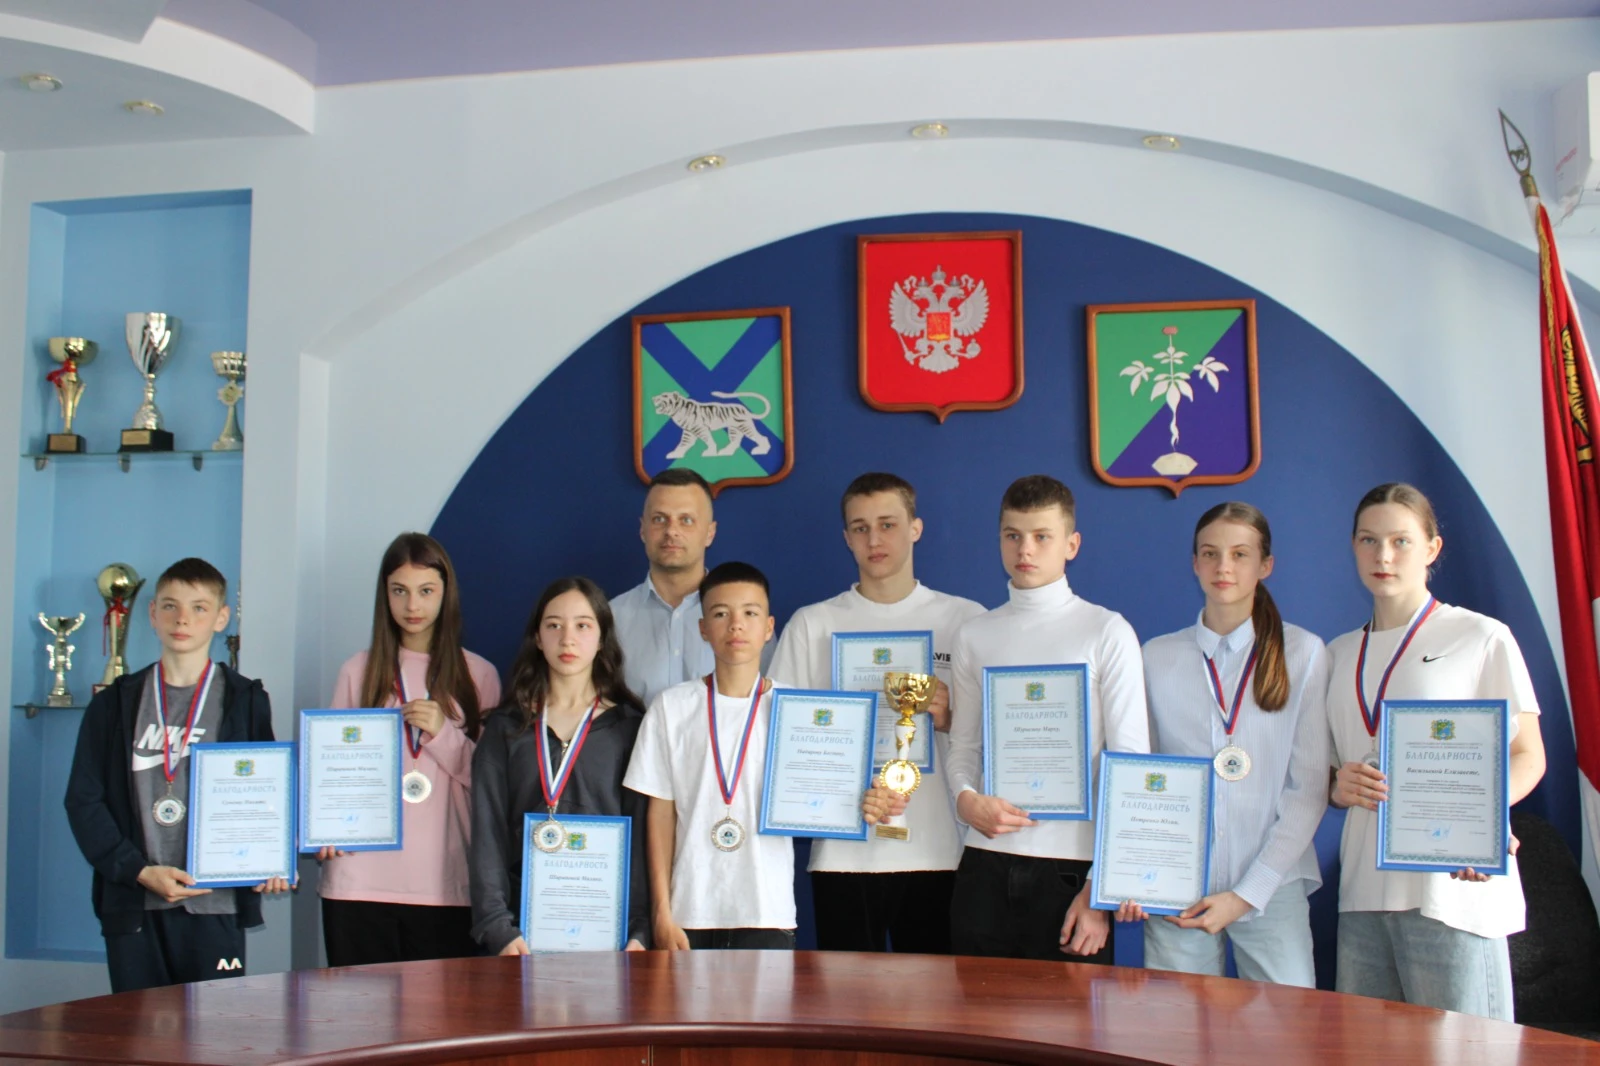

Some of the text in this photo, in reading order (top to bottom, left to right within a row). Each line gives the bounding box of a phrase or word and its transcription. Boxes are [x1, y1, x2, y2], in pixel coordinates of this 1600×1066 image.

[1005, 710, 1068, 720] БЛАГОДАРНОСТЬ
[137, 723, 206, 753] NIKE
[790, 734, 854, 745] БЛАГОДАРНОСТЬ
[1405, 751, 1483, 761] БЛАГОДАРНОСТЬ
[1406, 767, 1443, 775] Васильевой
[1121, 800, 1191, 813] БЛАГОДАРНОСТЬ
[544, 860, 609, 870] БЛАГОДАРНОСТЬ
